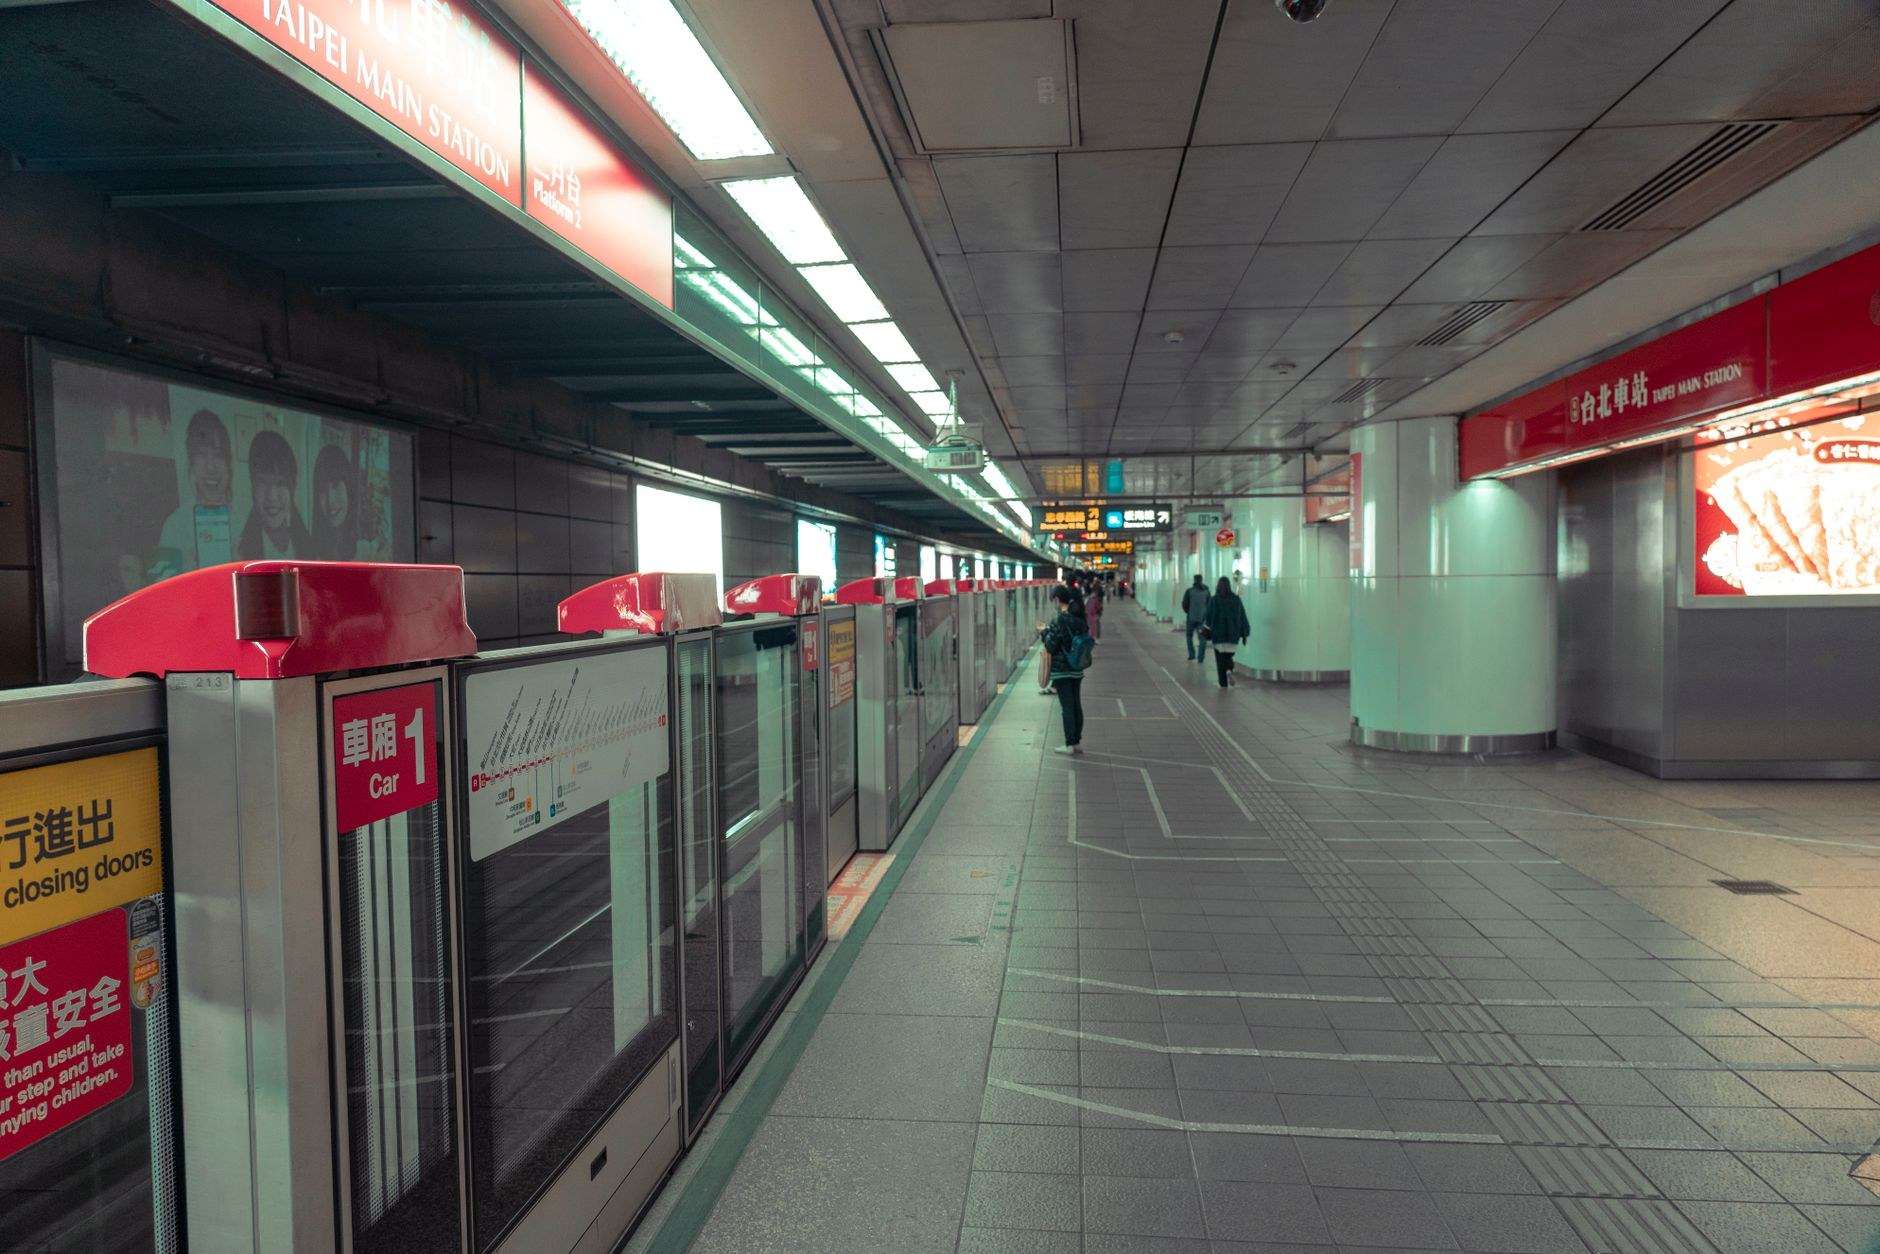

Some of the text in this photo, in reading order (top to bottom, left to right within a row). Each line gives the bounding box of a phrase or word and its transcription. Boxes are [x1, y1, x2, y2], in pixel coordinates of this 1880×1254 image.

[357, 50, 422, 126] MAIN
[428, 104, 509, 187] STATION
[1580, 371, 1648, 425] 台北車站
[1652, 363, 1742, 404] TAIPEI MAIN STATION
[196, 676, 222, 687] 213
[342, 713, 397, 767] 車廂
[405, 707, 425, 785] 1
[369, 772, 399, 799] Car
[4, 848, 153, 909] closing doors
[4, 1034, 95, 1088] than usual,
[17, 1077, 55, 1105] step
[59, 1057, 89, 1085] and
[92, 1043, 124, 1068] take
[52, 1067, 119, 1109] children.
